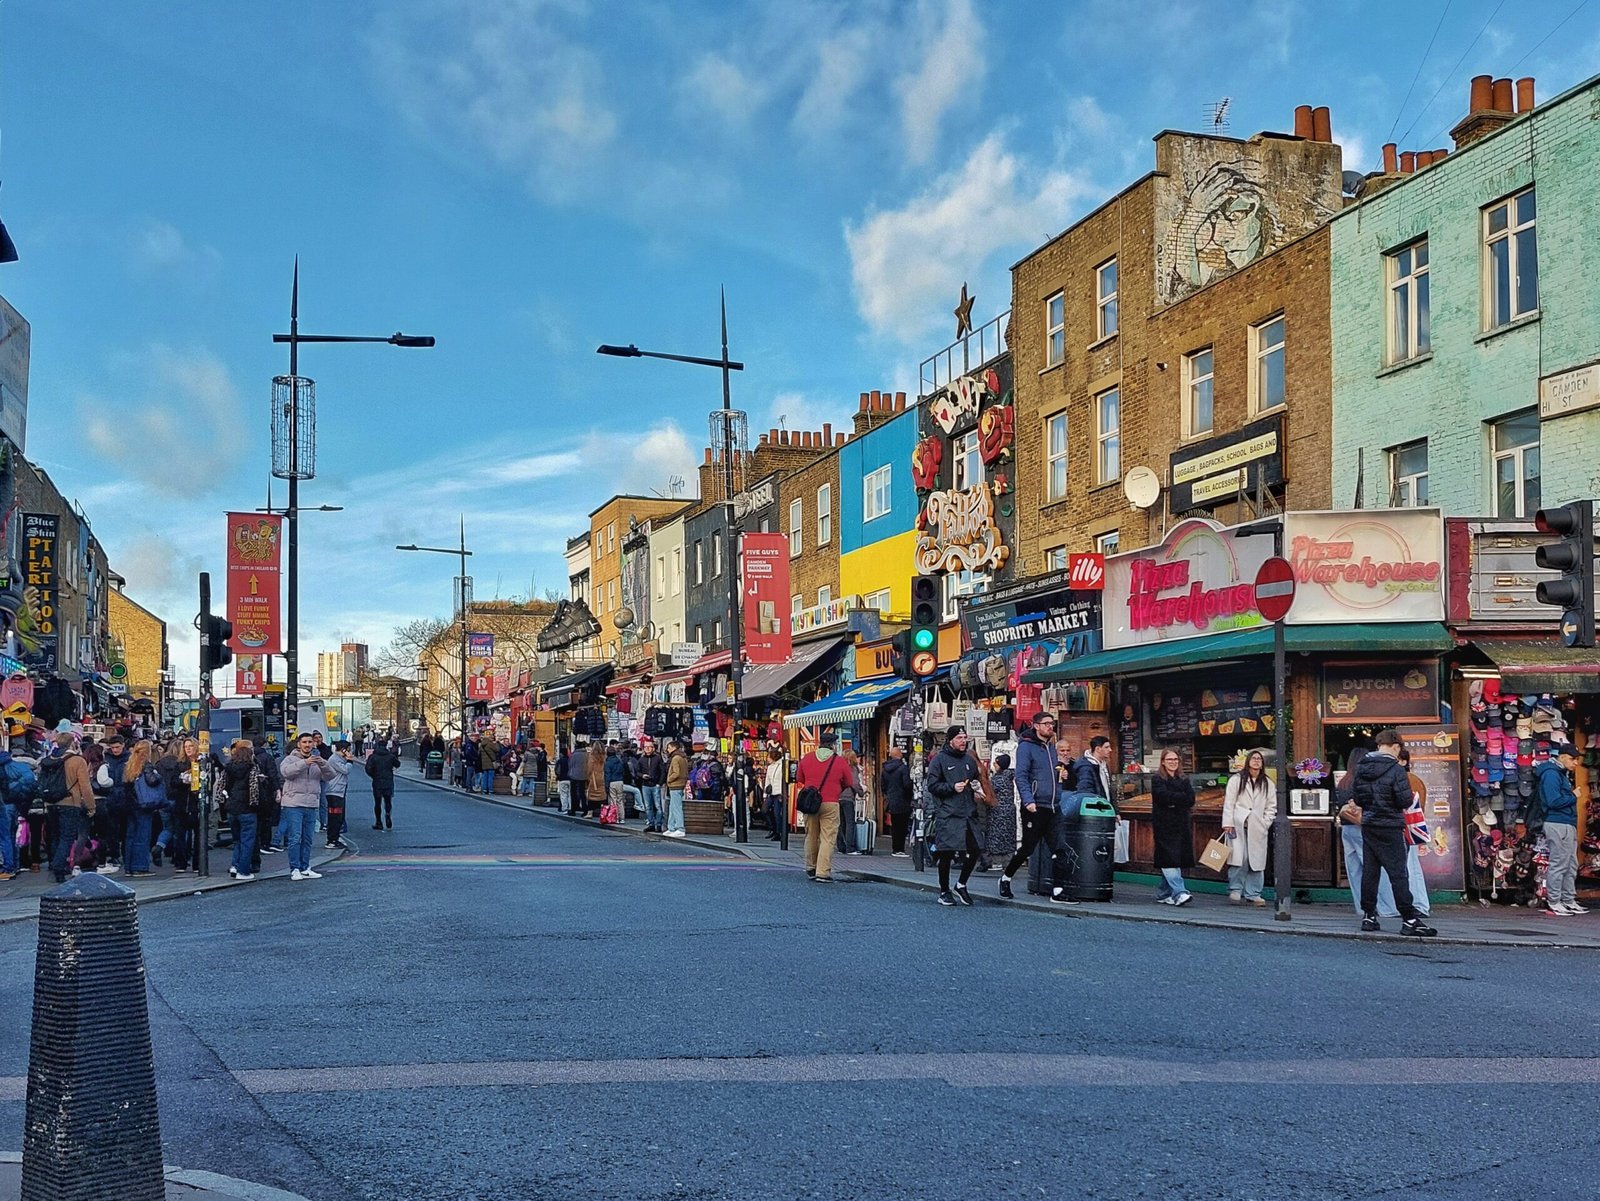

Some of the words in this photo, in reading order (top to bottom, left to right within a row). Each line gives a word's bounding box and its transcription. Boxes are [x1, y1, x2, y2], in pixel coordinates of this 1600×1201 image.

[1552, 377, 1589, 398] CAMDEN
[1562, 395, 1571, 408] ST
[1226, 449, 1247, 461] SCHOOL
[1249, 443, 1264, 454] BAGS
[1264, 438, 1276, 448] AND
[1193, 486, 1211, 497] TRAVEL
[1291, 535, 1354, 562] Pizza
[1130, 558, 1190, 595] Pizza
[1291, 556, 1441, 588] Warehouse
[41, 540, 53, 634] TATTOO
[1049, 606, 1067, 616] Vintage
[984, 623, 1035, 646] SHOPRITE
[1038, 610, 1088, 635] MARKET
[1342, 679, 1396, 690] DUTCH
